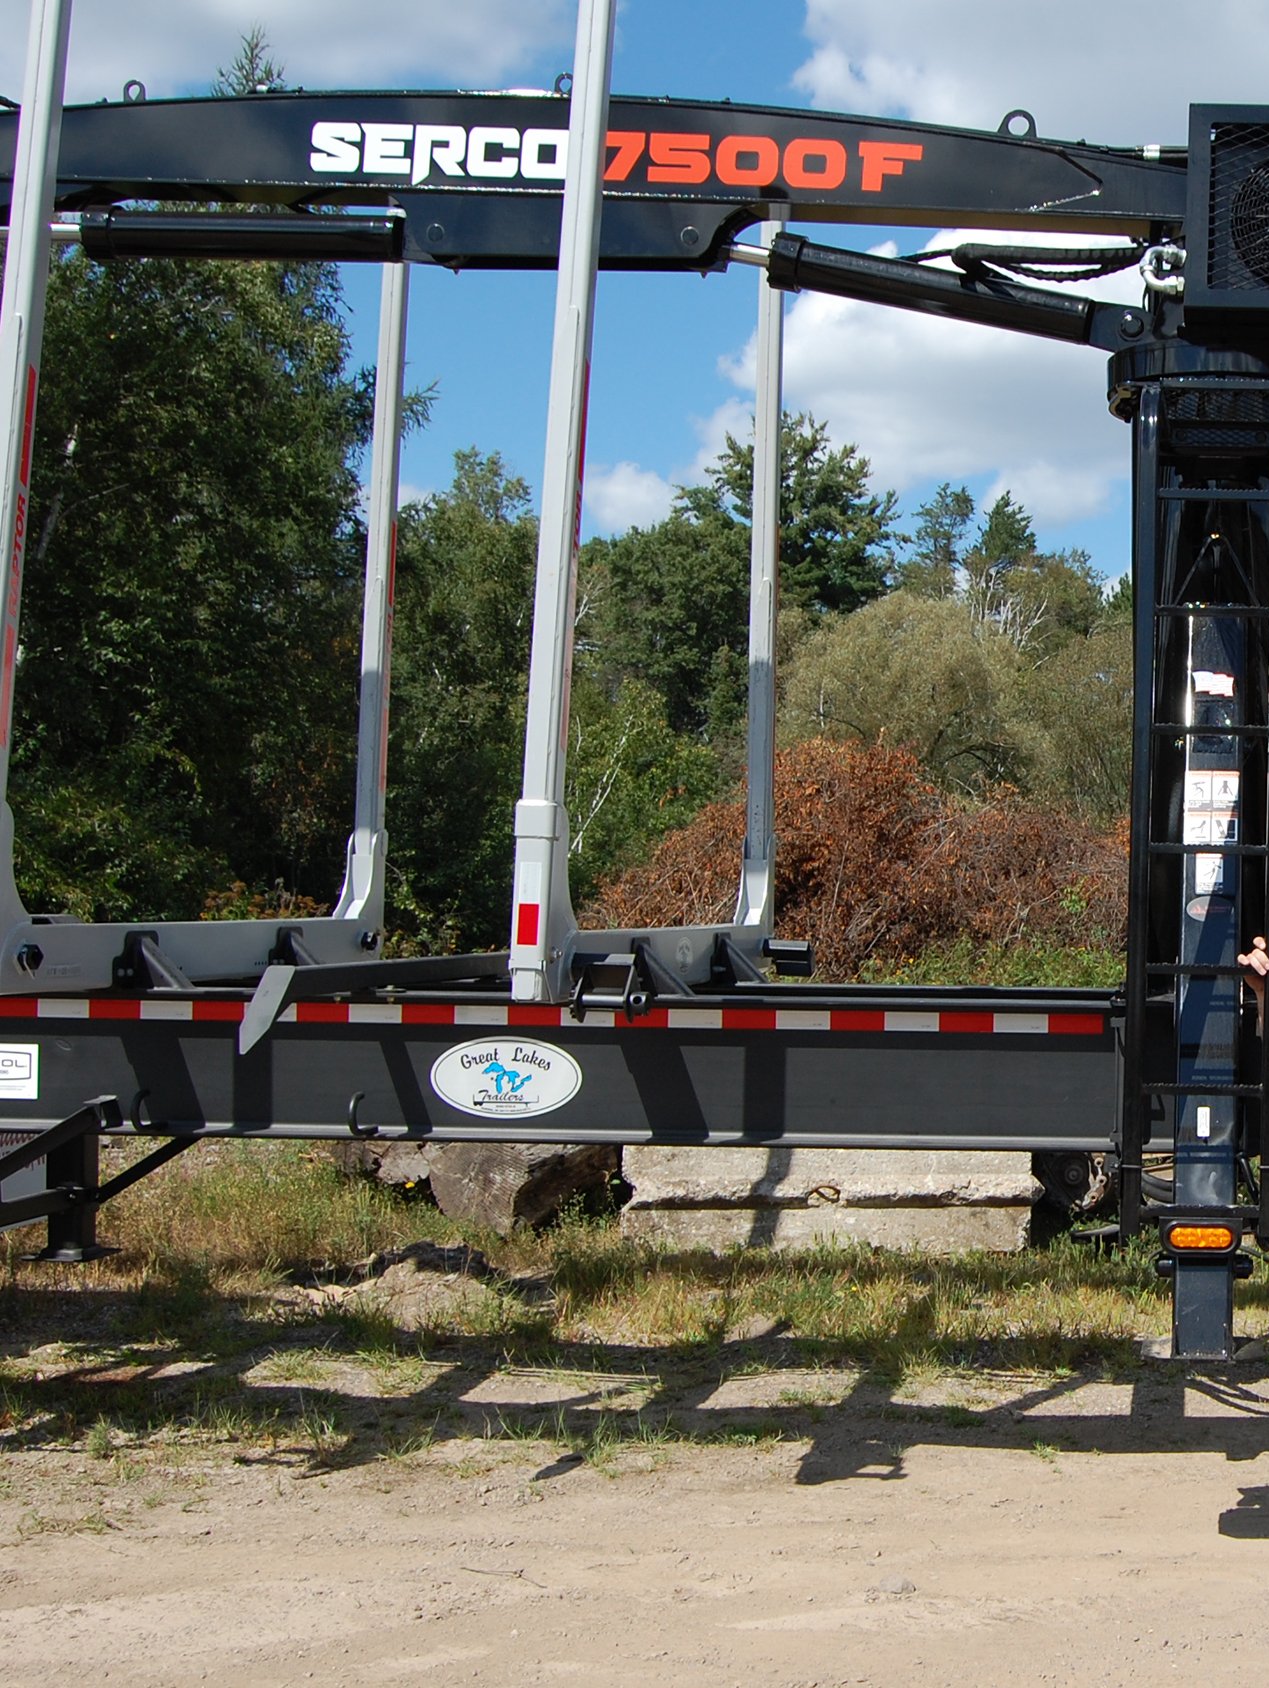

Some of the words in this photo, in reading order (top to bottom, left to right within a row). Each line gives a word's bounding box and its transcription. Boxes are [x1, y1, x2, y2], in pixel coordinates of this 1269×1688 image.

[310, 121, 570, 185] SERCO
[9, 491, 26, 618] RAPTOR
[460, 1048, 500, 1070] Great
[511, 1046, 552, 1071] Lakes
[478, 1089, 524, 1102] Trailers
